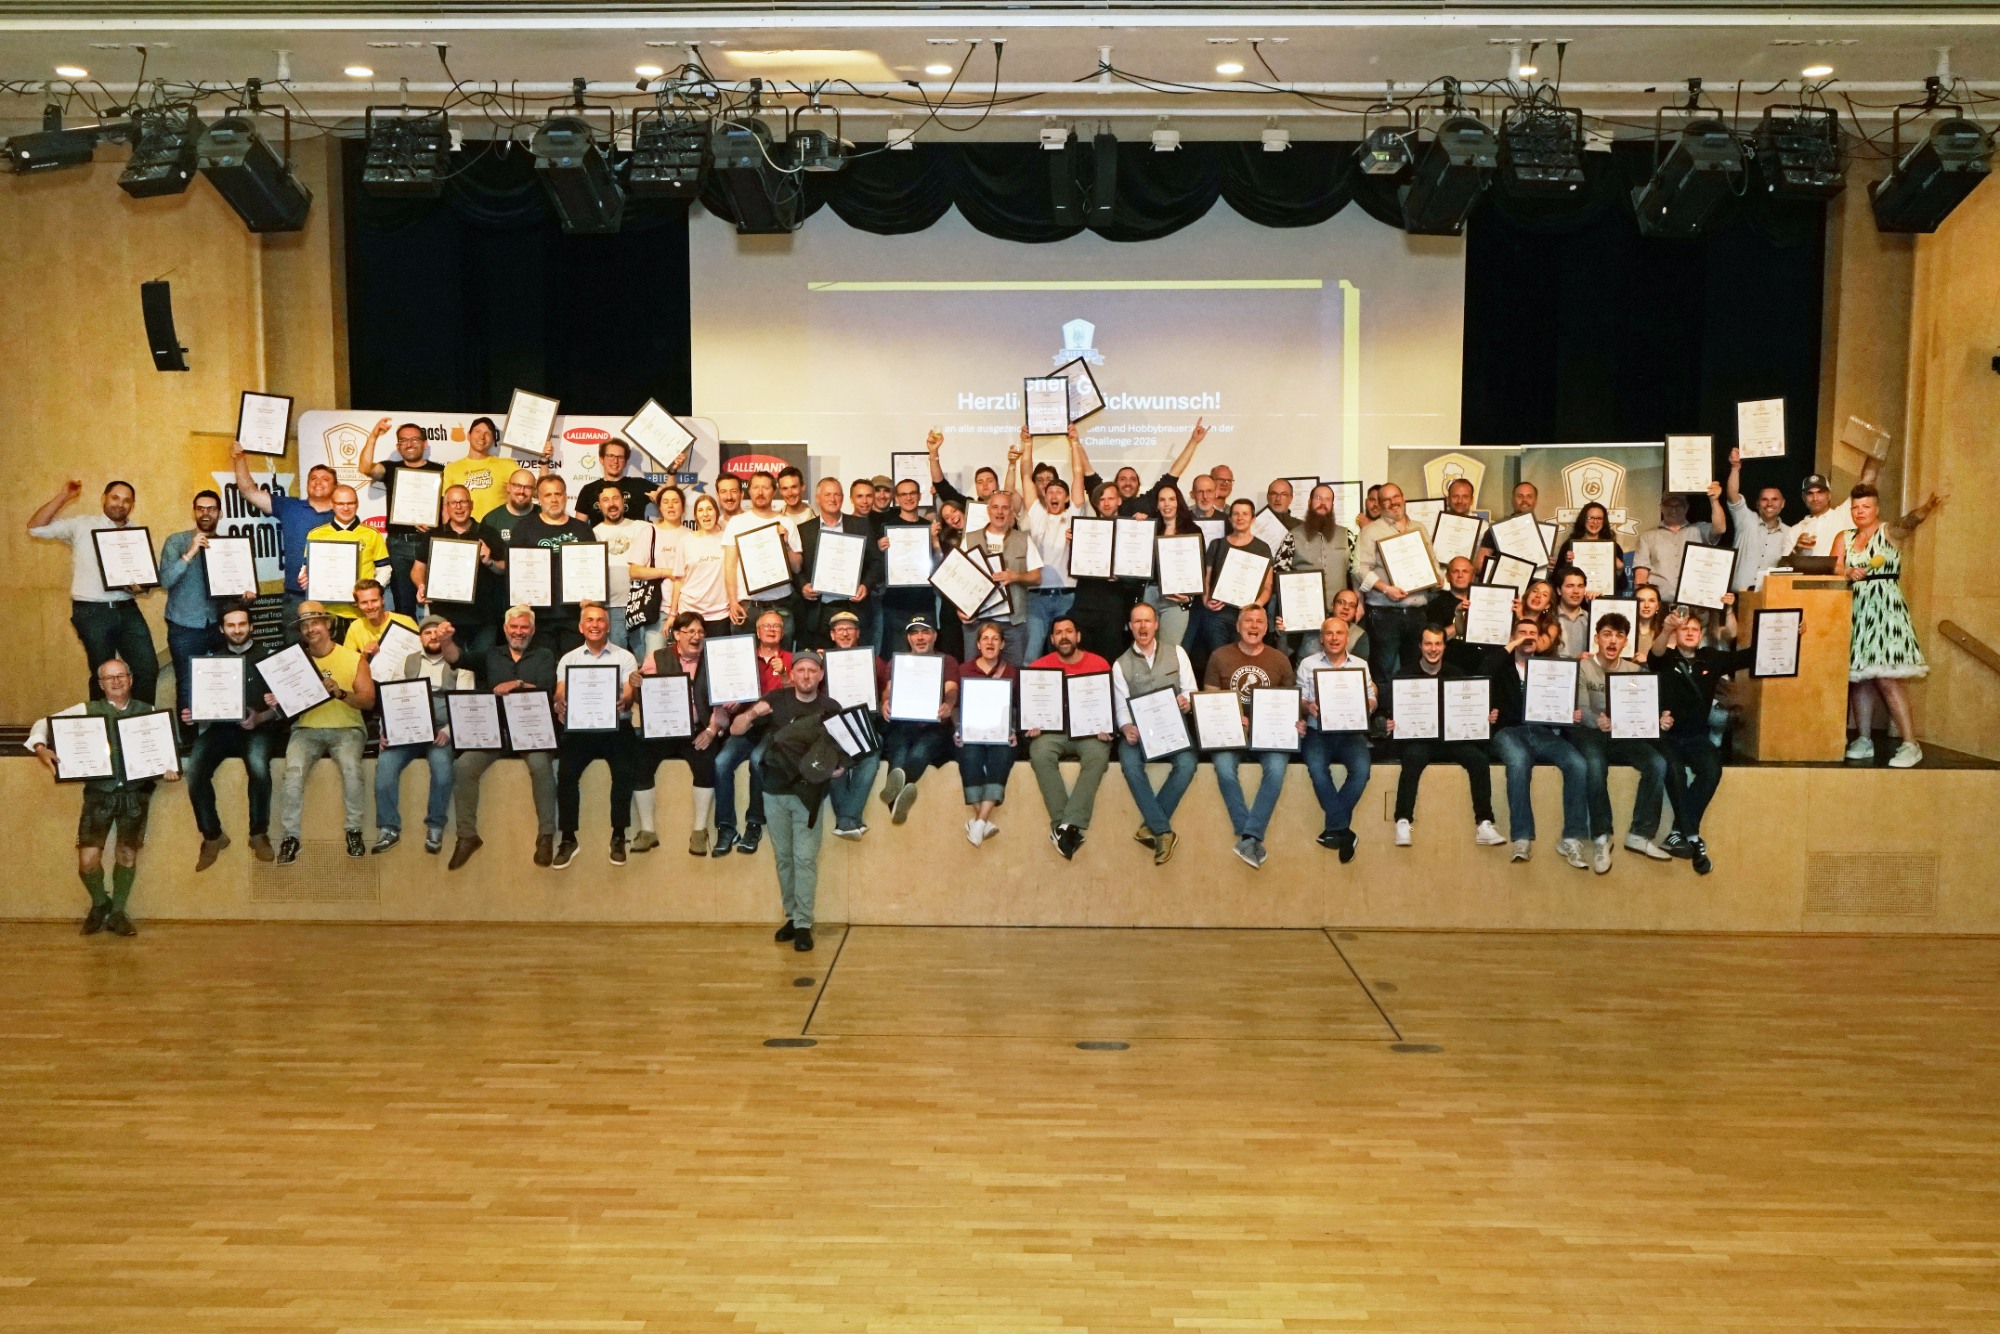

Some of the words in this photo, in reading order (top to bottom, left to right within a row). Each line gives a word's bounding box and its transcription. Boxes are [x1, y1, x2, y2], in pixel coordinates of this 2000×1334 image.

[944, 425, 956, 433] an
[958, 424, 976, 433] alle
[1108, 424, 1125, 433] und
[1219, 424, 1235, 433] der
[566, 432, 609, 440] LALLEMAND
[1085, 437, 1131, 447] Challenge
[1134, 437, 1157, 446] 2026
[727, 462, 787, 473] LALLEMAND
[651, 474, 668, 483] BIE
